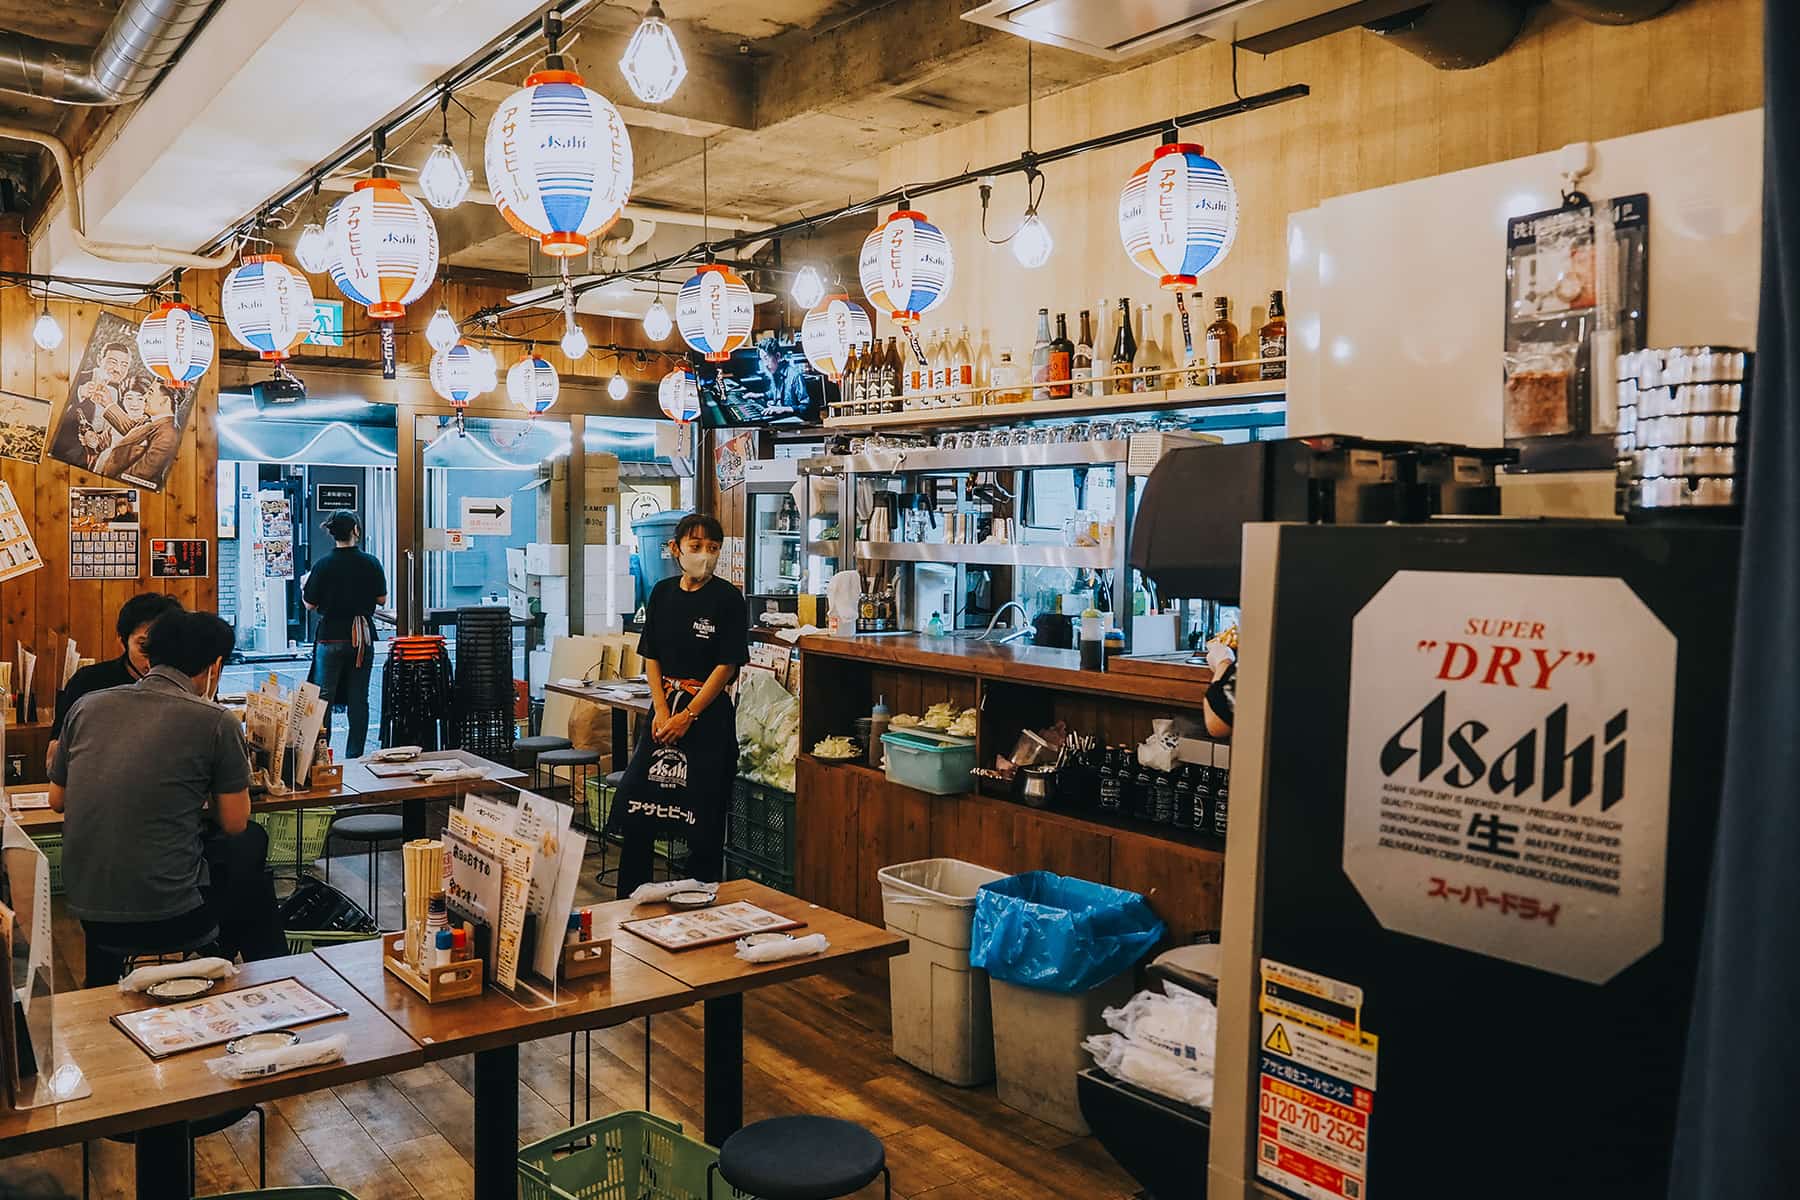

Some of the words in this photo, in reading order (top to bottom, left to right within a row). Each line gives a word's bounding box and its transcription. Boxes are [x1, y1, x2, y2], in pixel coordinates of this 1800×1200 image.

[502, 106, 528, 202] アサヒビール
[539, 135, 587, 150] Asahi
[1159, 168, 1176, 246] アサヒビール
[1194, 196, 1228, 213] Asahi
[347, 205, 369, 281] アサヒビール
[382, 230, 416, 246] Asahi
[890, 229, 904, 290] アサヒビール
[919, 254, 945, 267] Asahi
[709, 284, 723, 336] アサヒビール
[1463, 616, 1547, 641] SUPER
[648, 759, 688, 780] Asahi
[1379, 689, 1629, 813] Asahi
[627, 799, 696, 825] アサヒビール
[1466, 812, 1520, 860] 生
[1427, 875, 1561, 927] スーパードライ
[1261, 1092, 1366, 1153] 0120-70-2525
